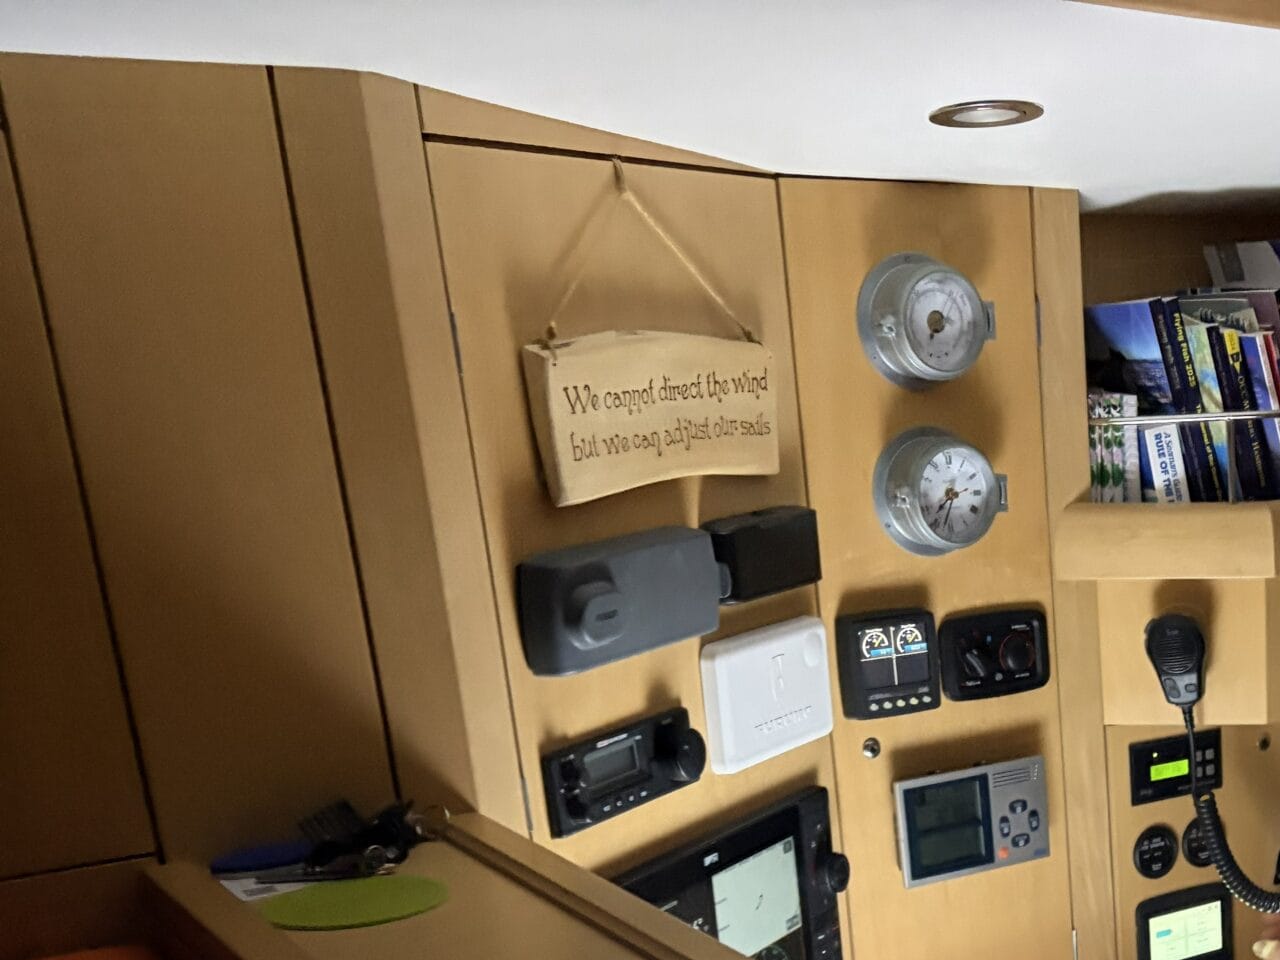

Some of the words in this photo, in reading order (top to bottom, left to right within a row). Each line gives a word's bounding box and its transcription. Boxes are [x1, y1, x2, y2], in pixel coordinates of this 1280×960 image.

[1173, 312, 1185, 342] Flying
[1181, 342, 1190, 363] Fish
[563, 384, 600, 415] We
[603, 377, 656, 416] cannot
[658, 372, 704, 402] direct
[706, 371, 730, 403] the
[731, 367, 769, 400] wind
[570, 431, 600, 462] but
[602, 433, 630, 455] we
[633, 431, 662, 457] can
[664, 416, 711, 451] adjust
[713, 415, 739, 438] our
[739, 411, 771, 437] sails
[1153, 432, 1167, 459] RULE
[1159, 461, 1170, 476] OF
[1163, 478, 1174, 497] THE
